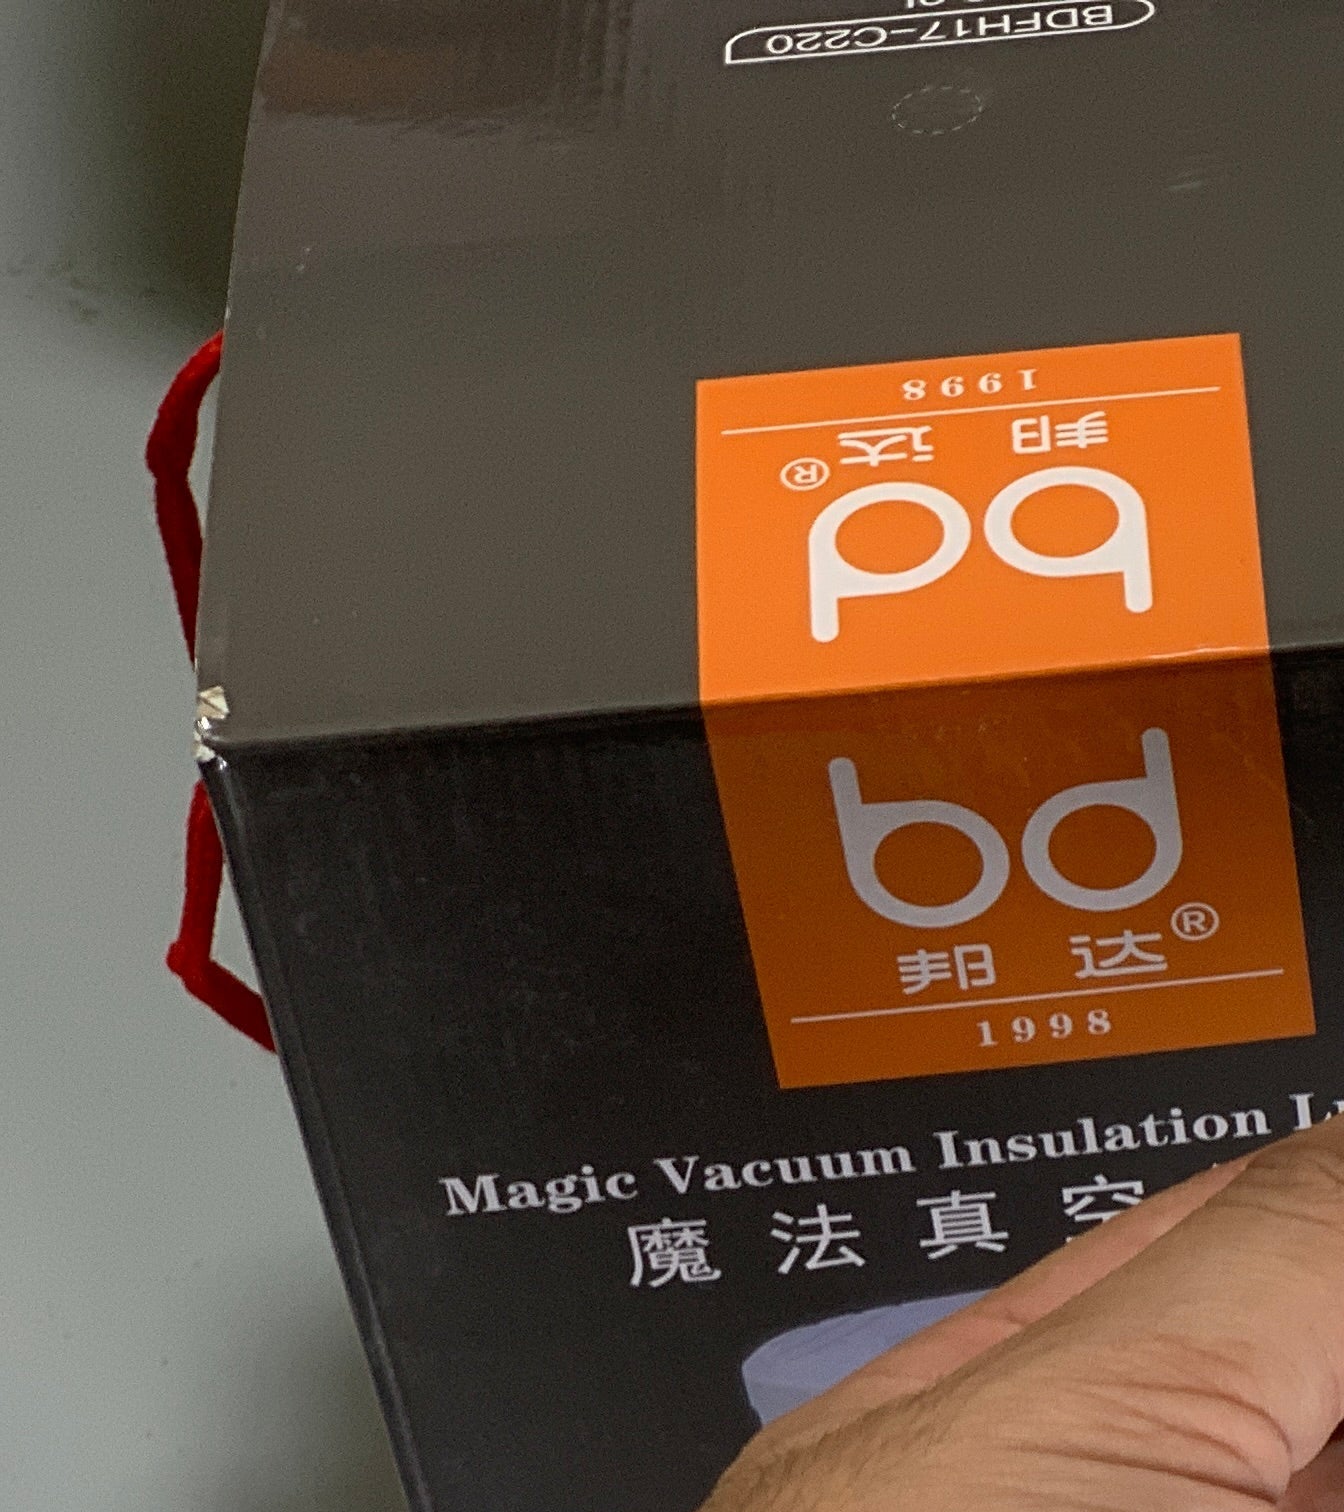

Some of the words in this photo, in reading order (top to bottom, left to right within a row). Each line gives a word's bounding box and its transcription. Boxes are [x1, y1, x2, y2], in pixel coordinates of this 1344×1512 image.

[902, 367, 1039, 402] 1998
[827, 727, 1184, 928] bd
[976, 1008, 1113, 1048] 1998
[440, 1166, 637, 1220] Magic
[654, 1143, 916, 1196] Vacuum
[932, 1106, 1272, 1170] Insulation
